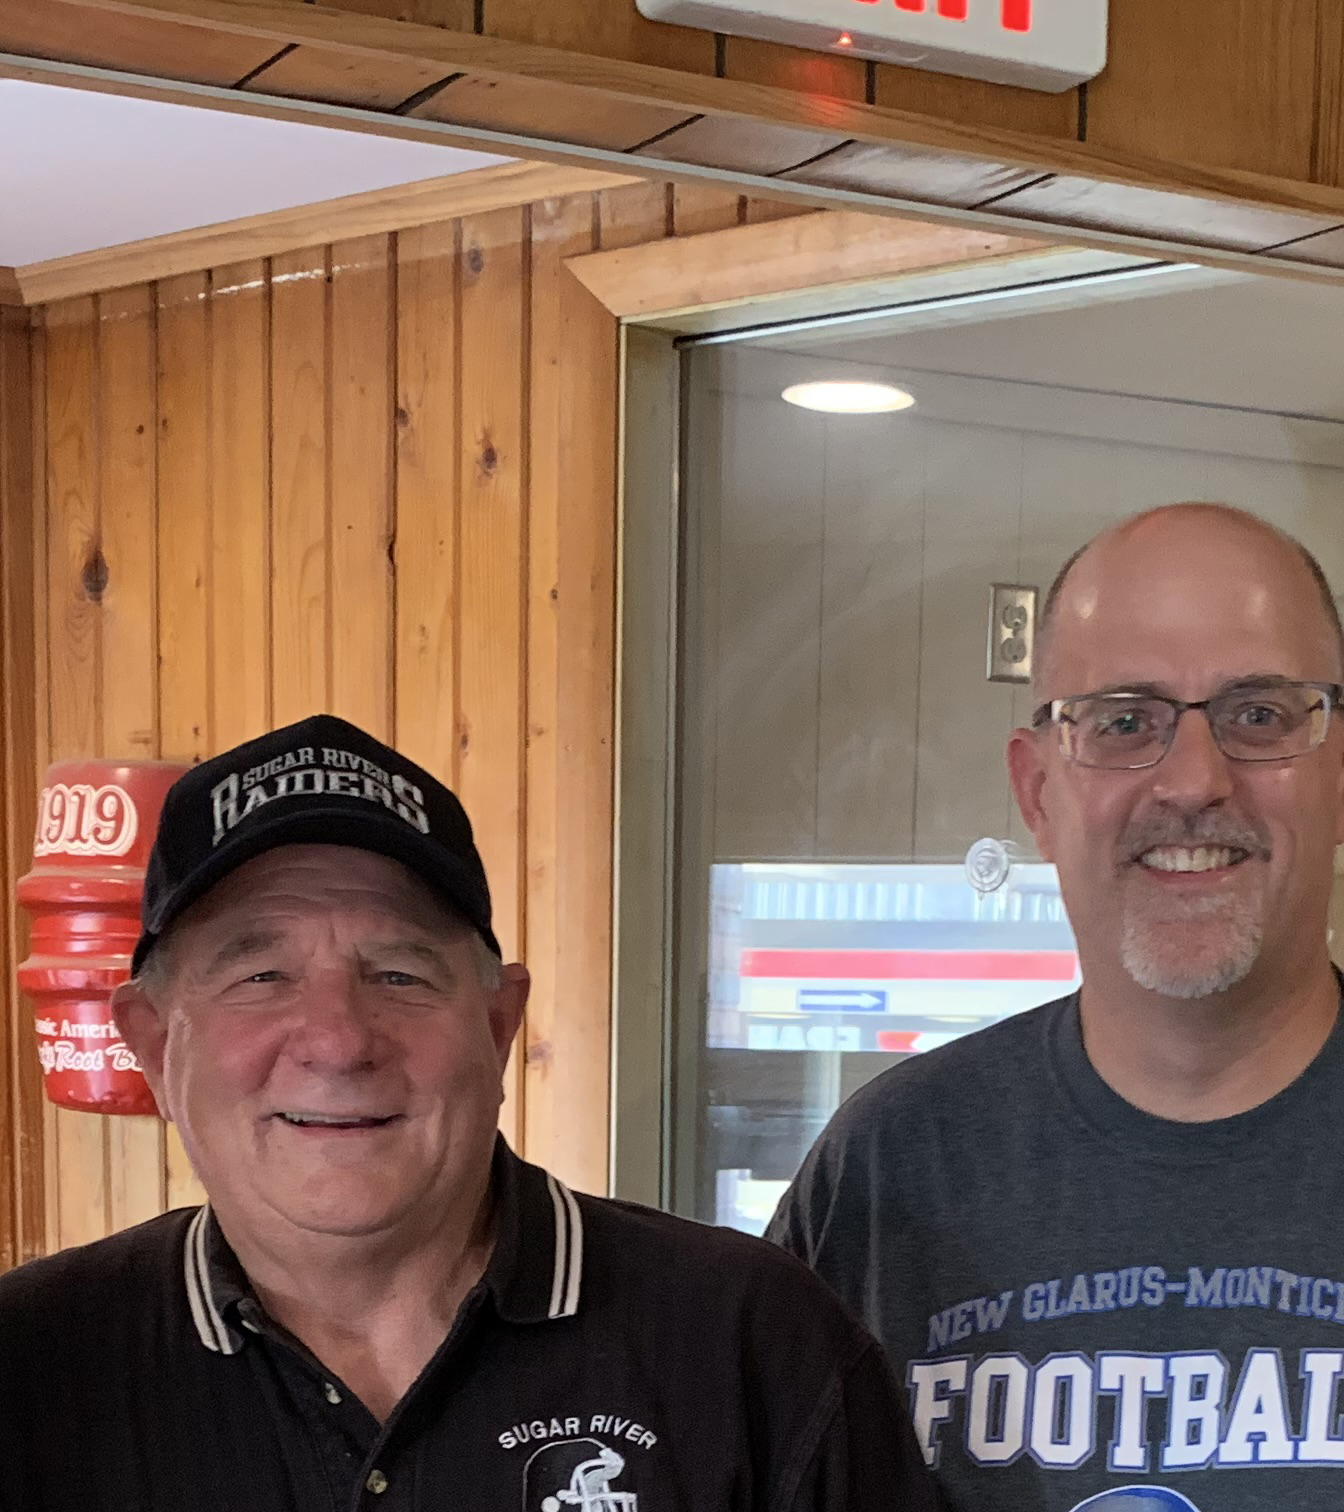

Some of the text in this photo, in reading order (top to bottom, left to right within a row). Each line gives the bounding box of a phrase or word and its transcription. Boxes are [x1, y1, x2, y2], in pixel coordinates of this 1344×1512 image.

[242, 746, 393, 791] SUGAR RIVER
[34, 783, 138, 858] 1919
[210, 767, 431, 847] RAIDERS
[927, 1291, 1014, 1353] NEW
[498, 1414, 658, 1450] SUGAR RIVER
